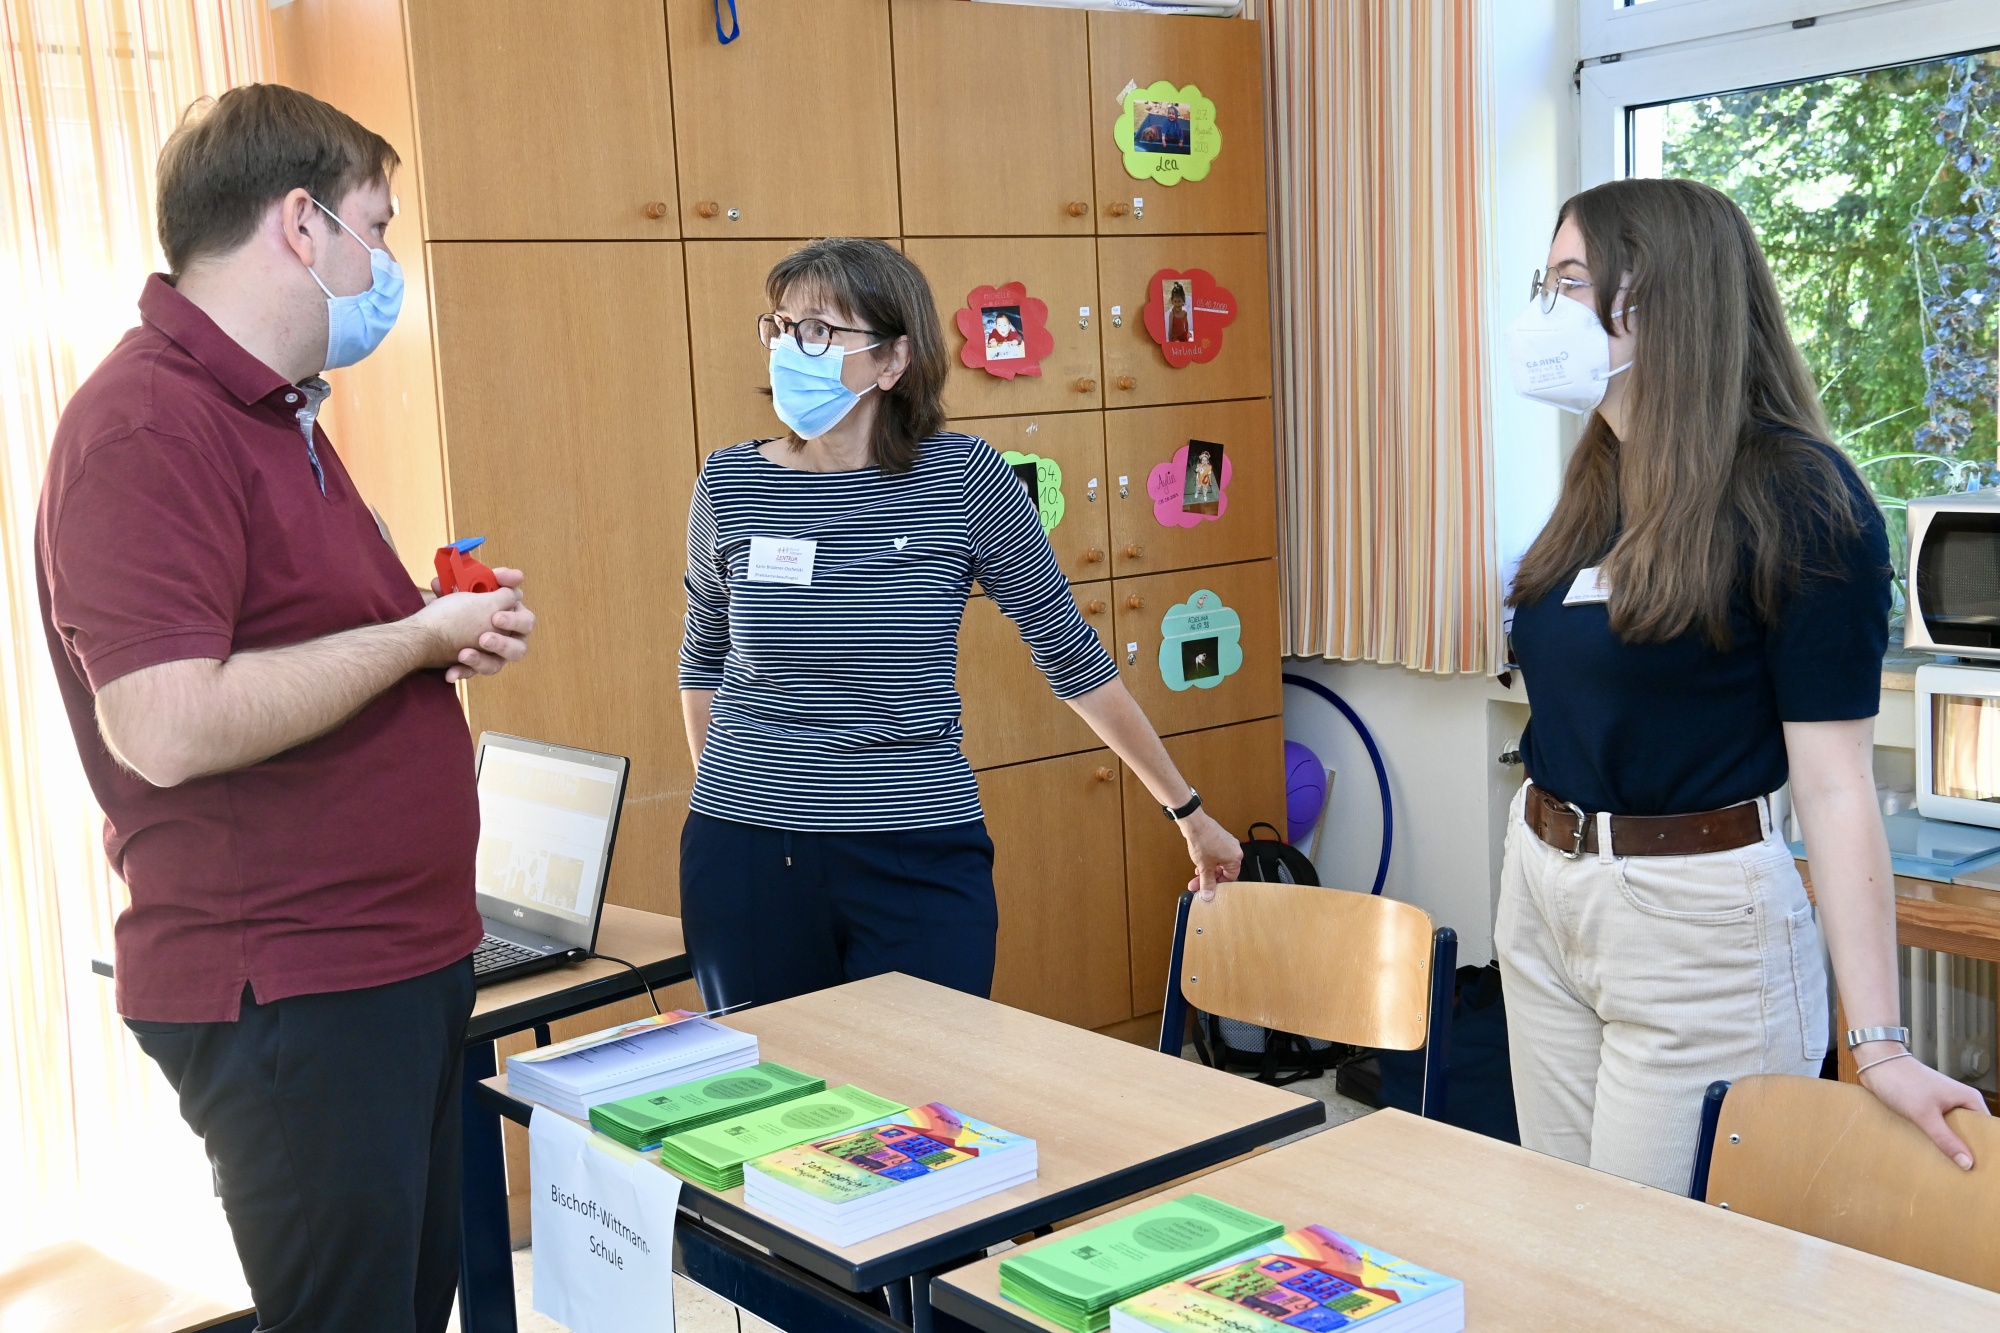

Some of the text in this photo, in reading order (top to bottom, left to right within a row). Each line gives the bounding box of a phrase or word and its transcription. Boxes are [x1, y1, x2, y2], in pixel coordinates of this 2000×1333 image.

[1155, 156, 1180, 172] Lea
[1039, 486, 1059, 505] 10.
[1040, 510, 1057, 528] 01
[550, 1183, 651, 1255] Bischoff-Wittmann-
[589, 1235, 624, 1271] Schule
